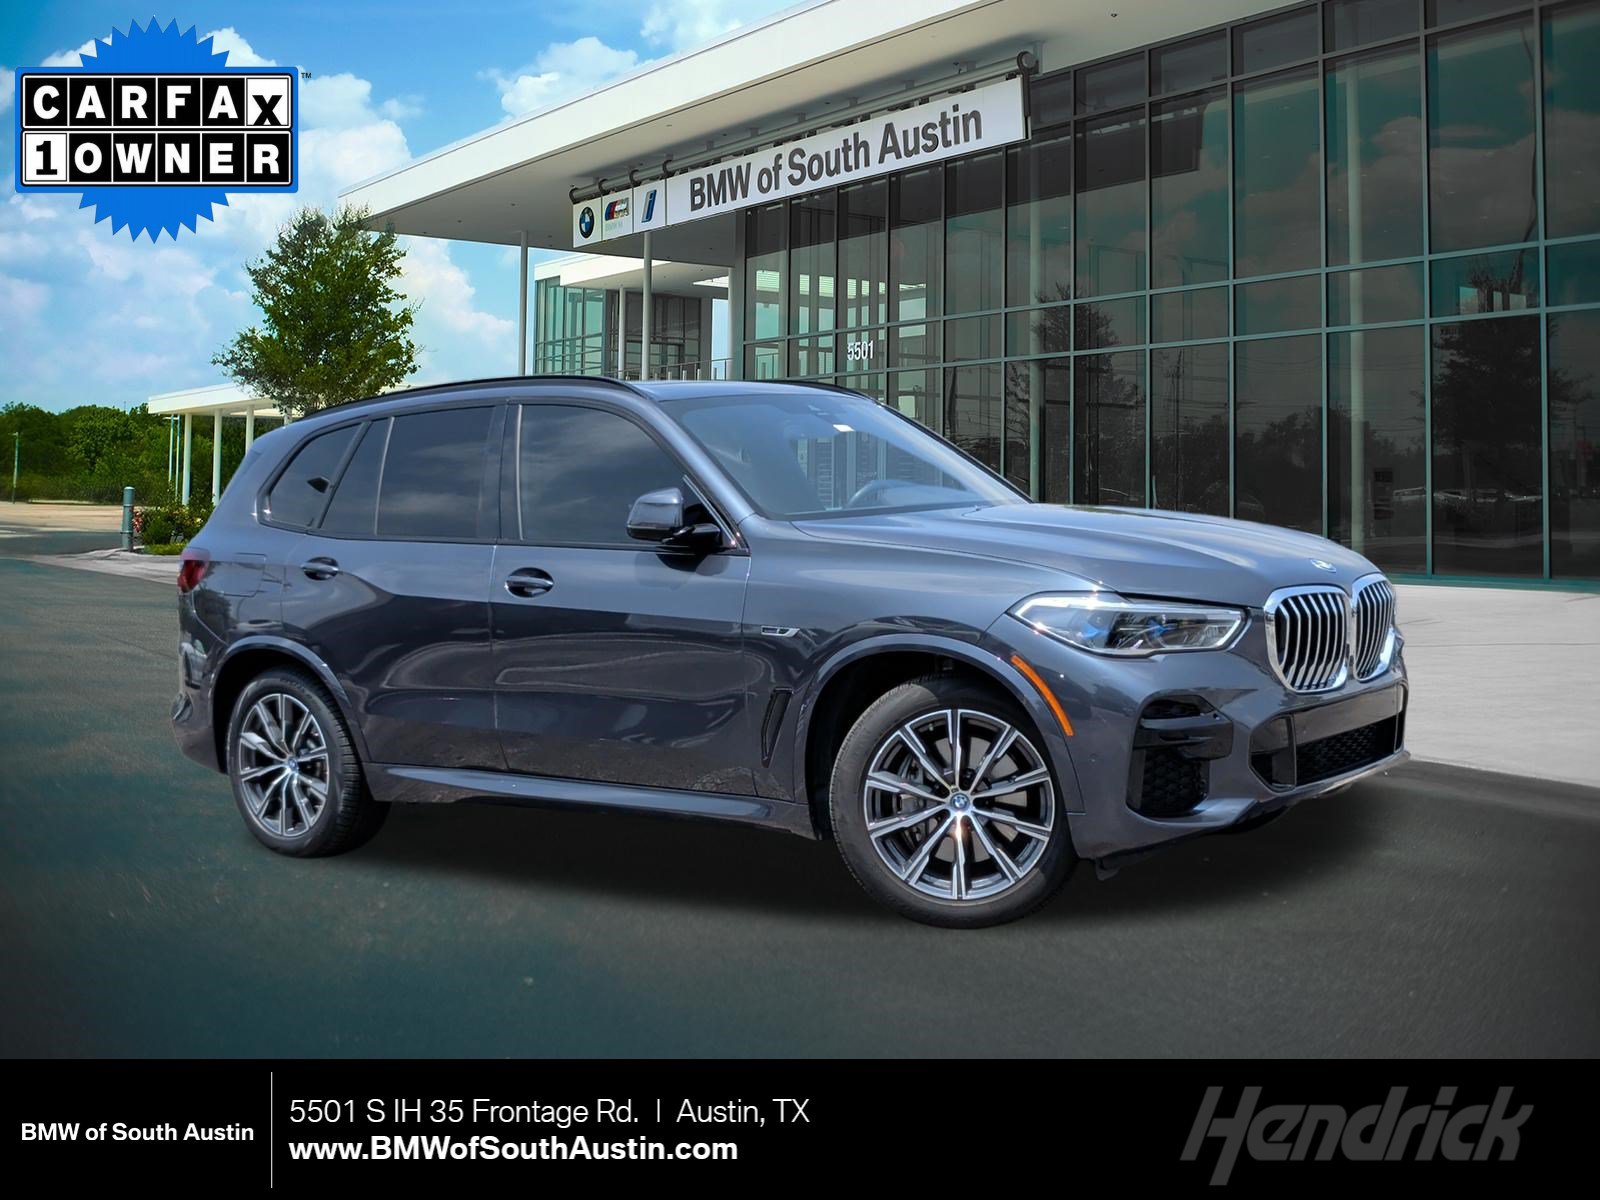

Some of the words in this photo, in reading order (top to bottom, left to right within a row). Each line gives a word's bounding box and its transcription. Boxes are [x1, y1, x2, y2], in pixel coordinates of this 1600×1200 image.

[690, 162, 751, 212] BMW
[757, 153, 782, 194] of
[788, 132, 870, 186] South
[878, 103, 982, 165] Austin
[847, 340, 873, 361] 5501
